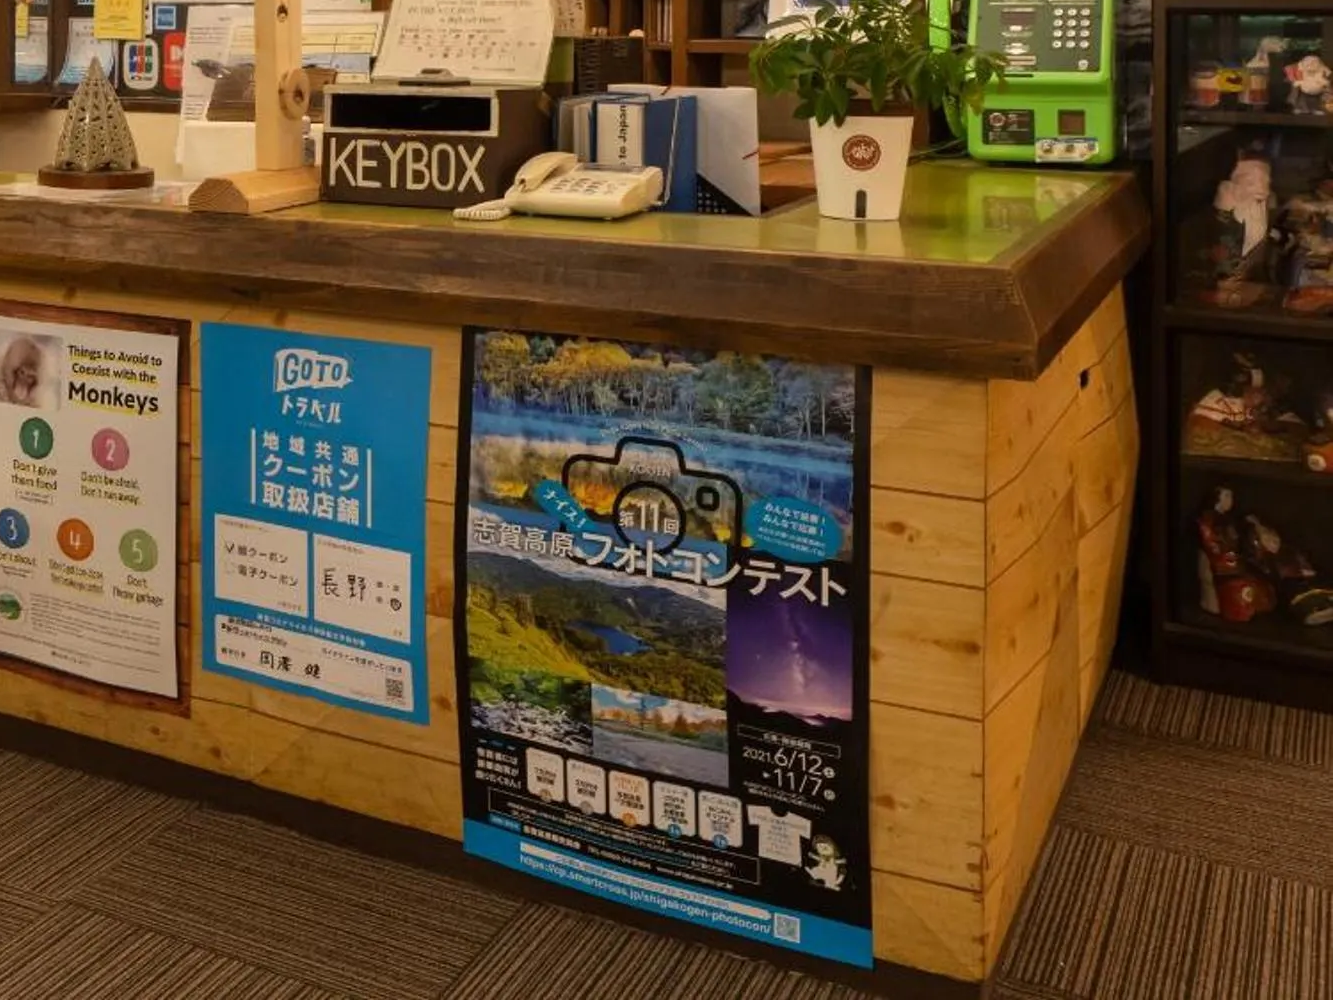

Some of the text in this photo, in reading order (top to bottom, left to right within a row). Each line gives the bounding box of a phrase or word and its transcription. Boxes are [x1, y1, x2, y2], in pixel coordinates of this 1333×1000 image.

[328, 138, 486, 194] KEYBOX
[67, 344, 163, 367] Things to Avoid to
[72, 361, 157, 384] Coexist with the
[68, 381, 160, 416] Monkeys
[281, 393, 343, 424] トラベル
[32, 429, 40, 449] 1
[104, 438, 117, 461] 2
[262, 430, 360, 467] 地域共通
[12, 459, 37, 473] Don't
[263, 453, 360, 492] クーポン
[11, 473, 58, 491] them food
[261, 480, 360, 526] 取扱店舗
[6, 515, 18, 541] 3
[618, 499, 680, 537] 第11回
[68, 530, 81, 551] 4
[131, 539, 143, 564] 5
[237, 563, 299, 588] 電子クーポン
[472, 516, 575, 559] 志賀高原
[577, 528, 848, 608] フォトコンテスト
[321, 566, 367, 602] 長野
[773, 768, 823, 797] 11/7
